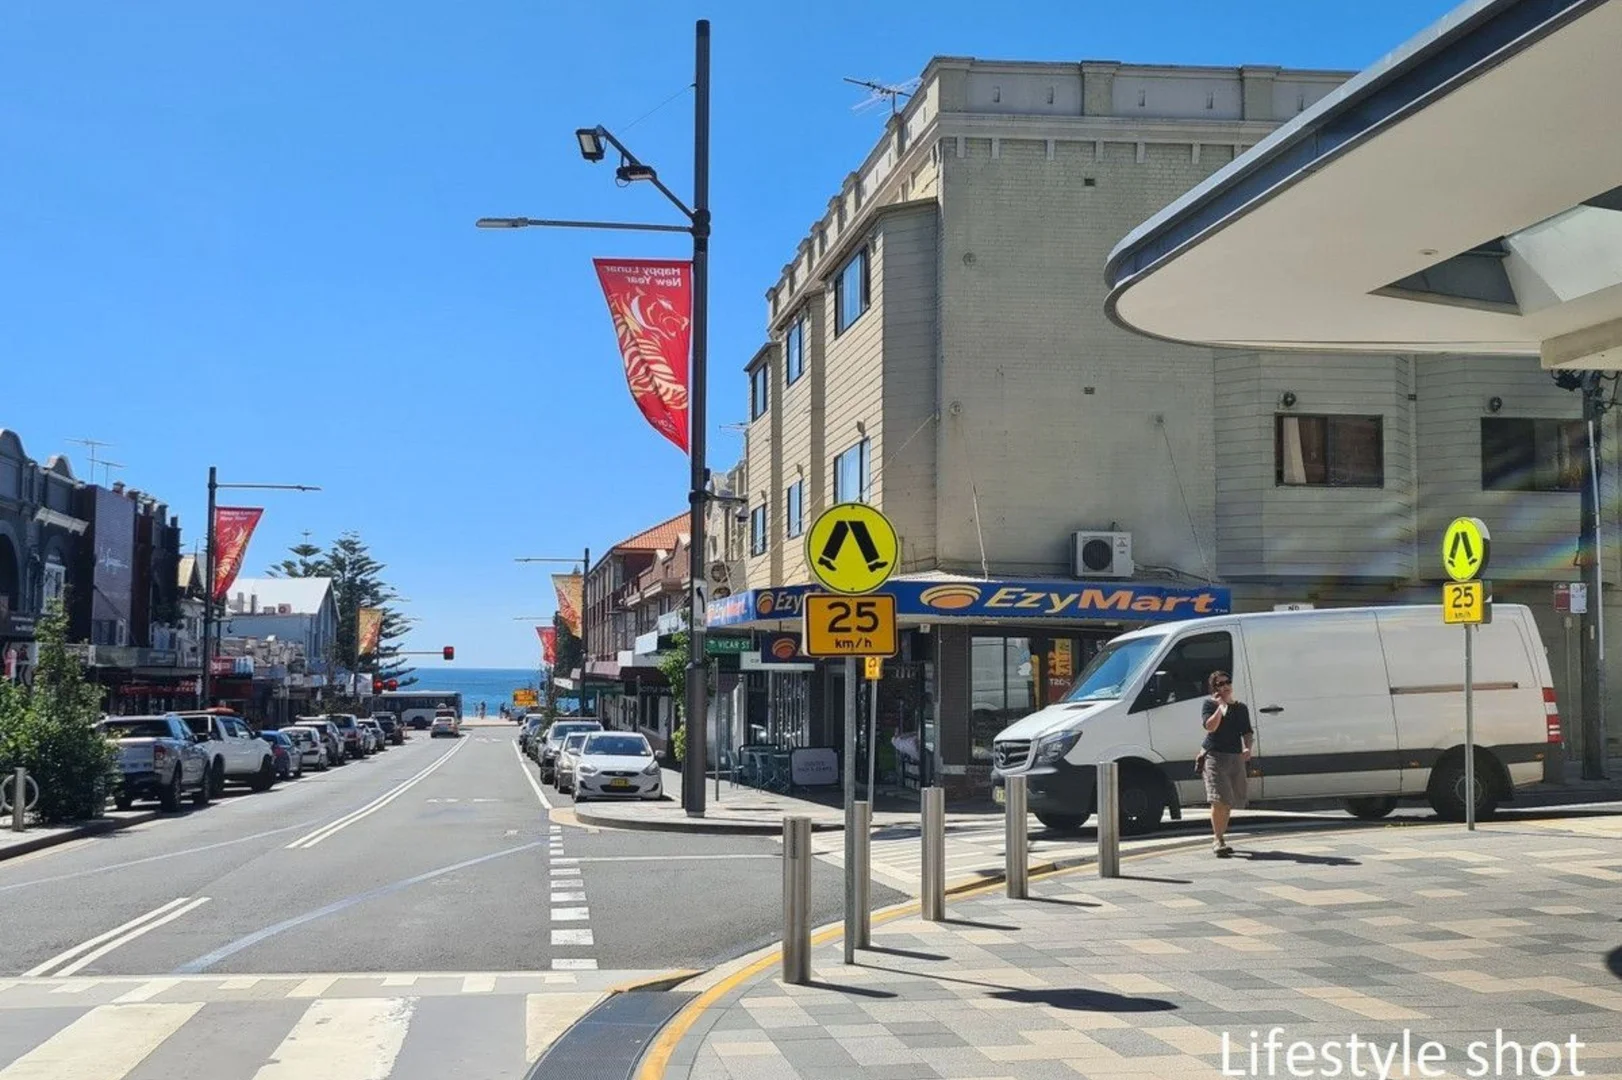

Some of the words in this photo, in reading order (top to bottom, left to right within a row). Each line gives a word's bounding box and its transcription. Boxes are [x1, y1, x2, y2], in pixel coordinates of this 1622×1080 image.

[774, 591, 803, 615] Ezy
[984, 587, 1216, 613] EzyMart
[1452, 586, 1474, 608] 25
[827, 601, 879, 633] 25
[717, 640, 740, 649] VICAR
[834, 637, 872, 649] km/h
